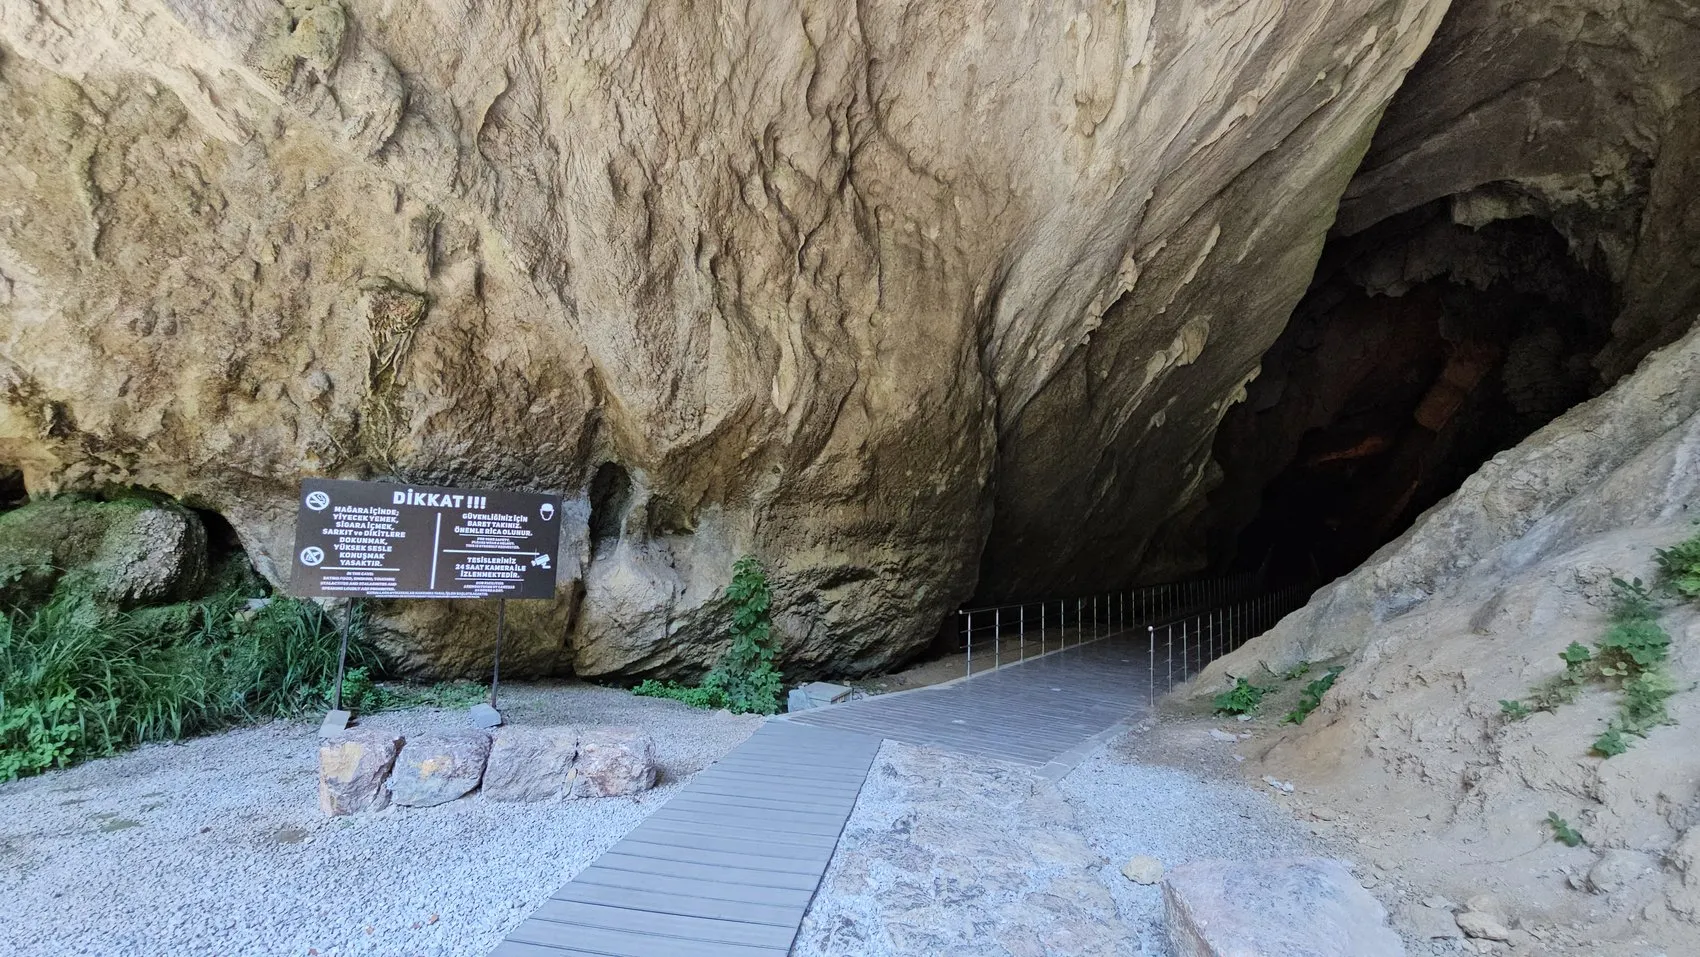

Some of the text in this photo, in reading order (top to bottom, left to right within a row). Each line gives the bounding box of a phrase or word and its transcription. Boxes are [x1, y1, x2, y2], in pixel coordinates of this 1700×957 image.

[393, 488, 487, 509] DİKKAT !!!
[334, 506, 369, 514] MAĞARA
[333, 513, 399, 523] YİYECEK YEMEK,
[462, 512, 528, 523] GÜVENLİĞİNİZ İÇİN
[336, 521, 395, 531] SİGARA İÇMEK,
[454, 526, 484, 534] ÖNEMLE
[364, 529, 406, 538] DİKİTLERE
[339, 537, 388, 545] DOKUNMAK,
[334, 543, 367, 551] YÜKSEK
[339, 552, 385, 560] KONUŞMAK
[340, 559, 383, 567] YASAKTIR.
[514, 564, 526, 572] İLE
[460, 570, 520, 578] İZLENMEKTEDİR.
